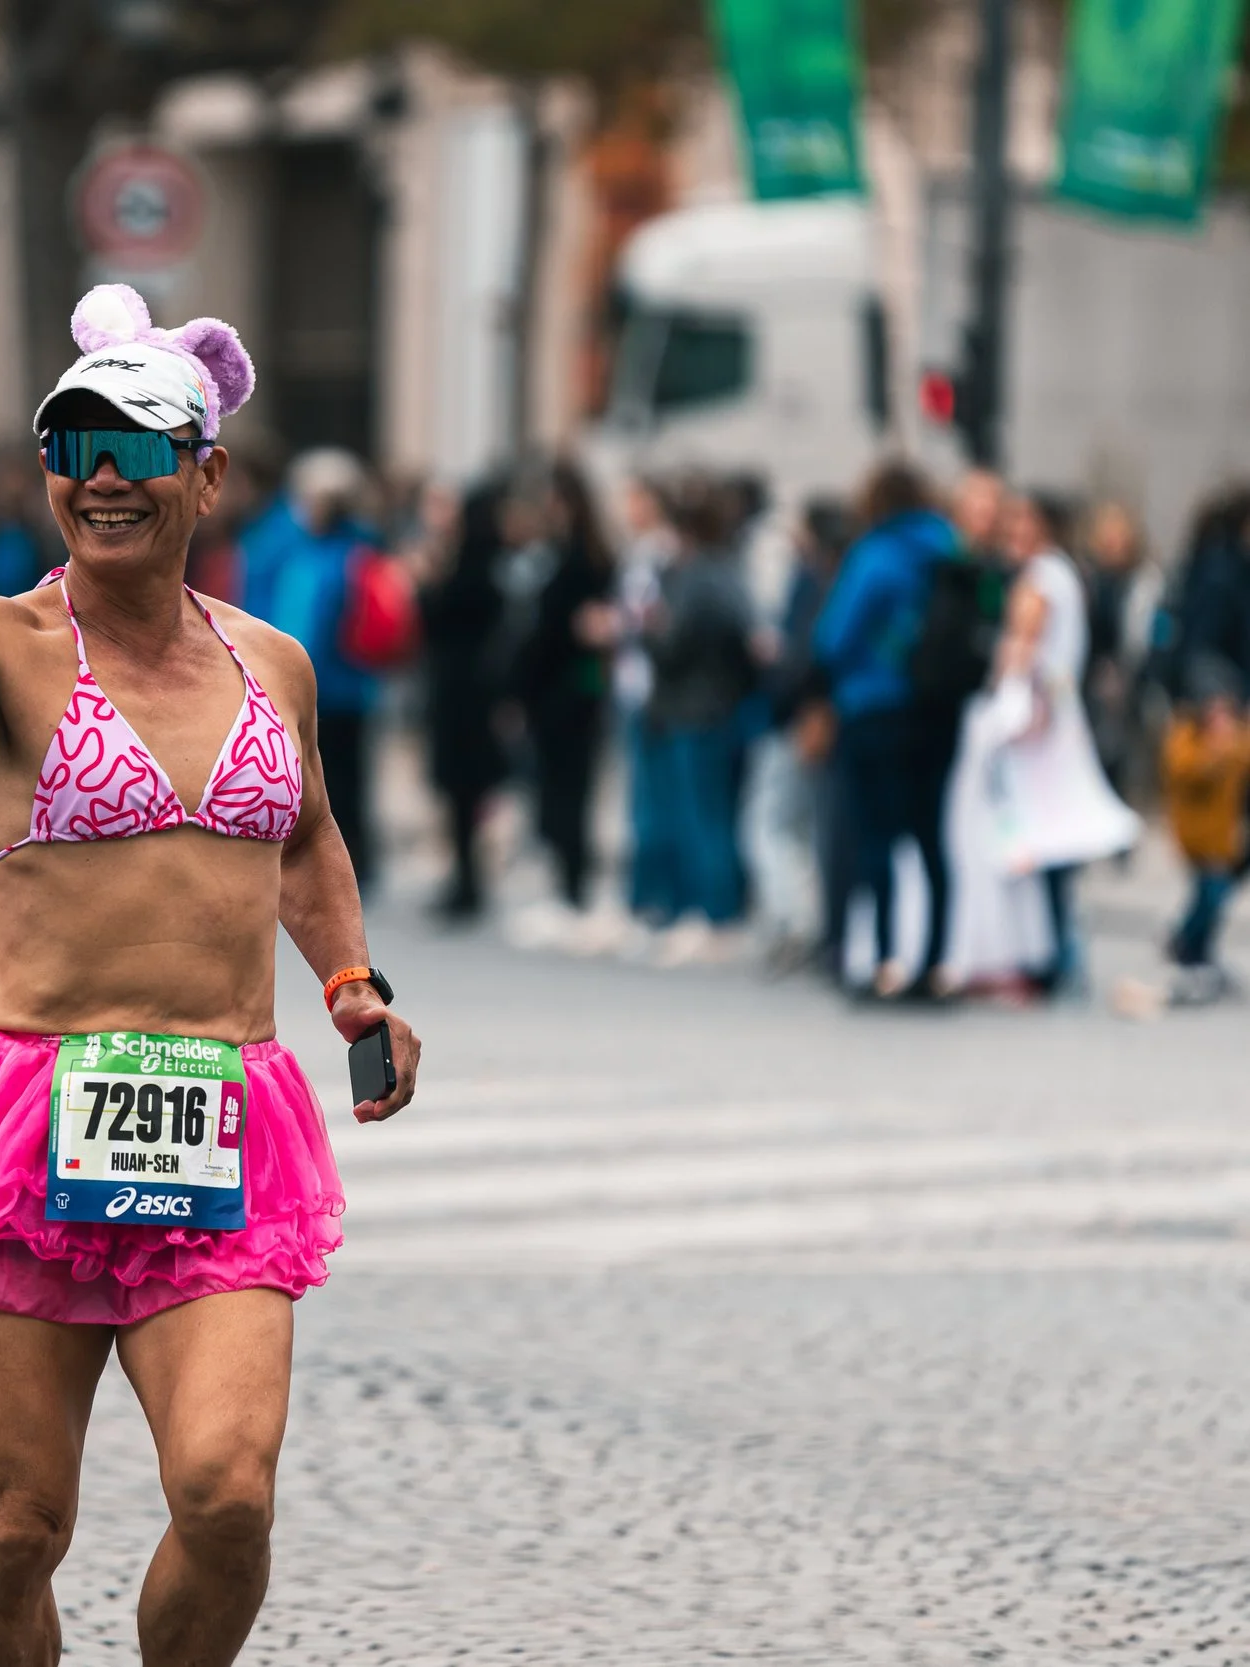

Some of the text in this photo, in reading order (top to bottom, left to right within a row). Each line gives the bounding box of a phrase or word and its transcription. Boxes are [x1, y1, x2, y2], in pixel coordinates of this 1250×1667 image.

[111, 1033, 221, 1062] Schneider
[164, 1058, 222, 1076] Electric
[83, 1081, 207, 1146] 72916
[111, 1152, 179, 1173] HUAN-SEN
[135, 1194, 192, 1217] asics
